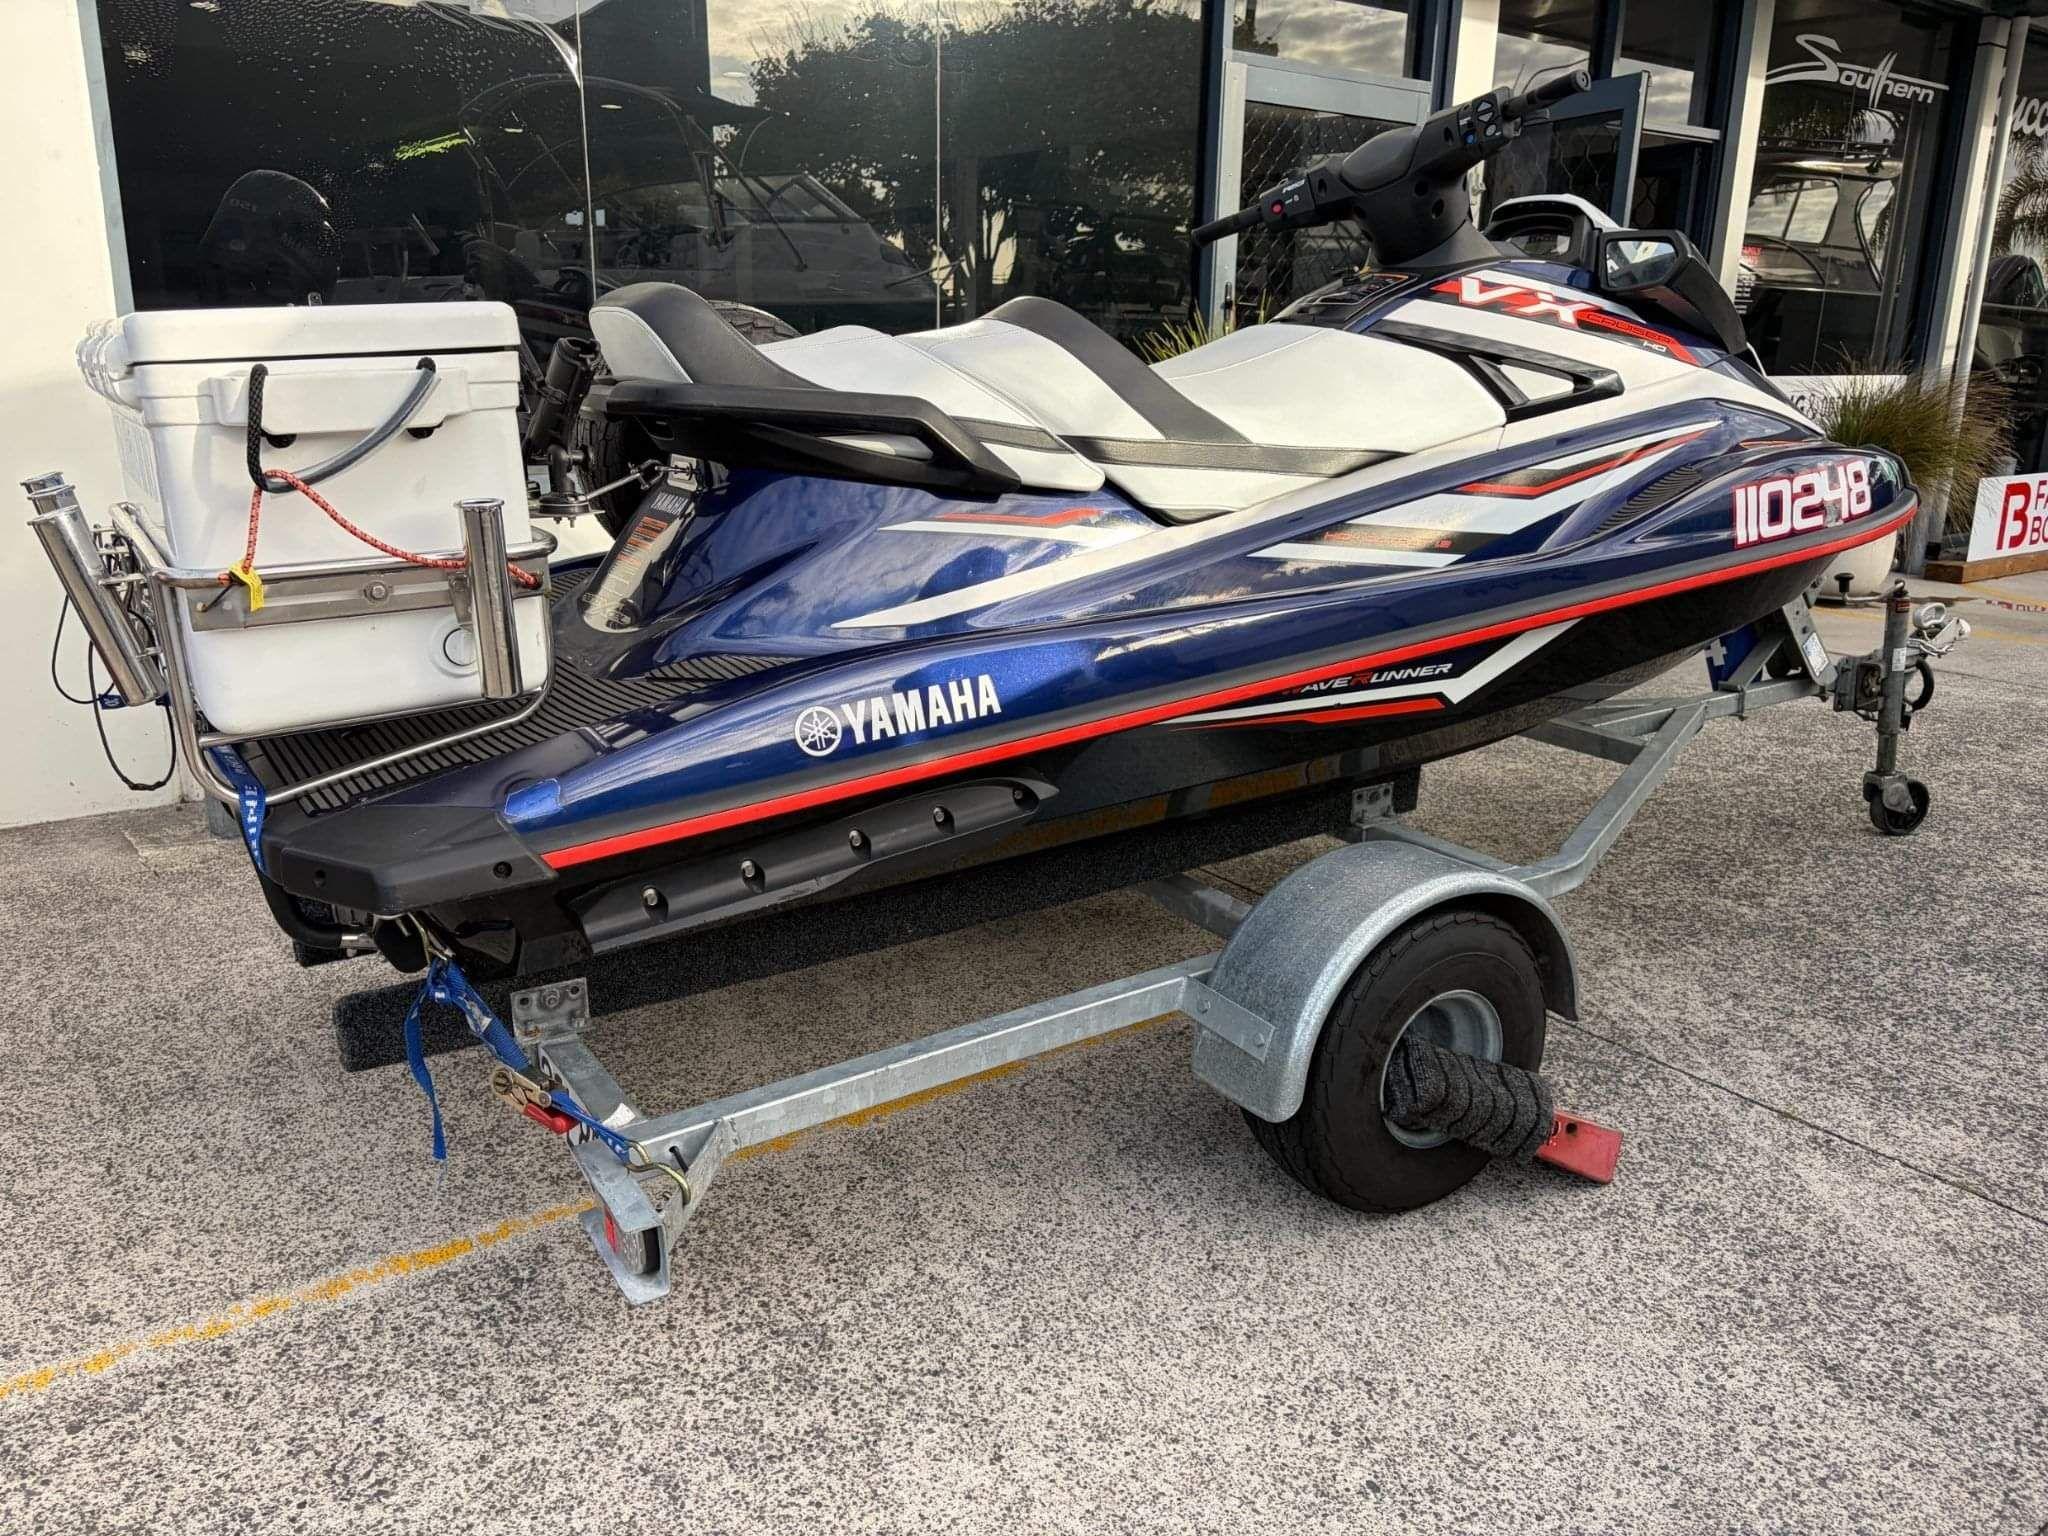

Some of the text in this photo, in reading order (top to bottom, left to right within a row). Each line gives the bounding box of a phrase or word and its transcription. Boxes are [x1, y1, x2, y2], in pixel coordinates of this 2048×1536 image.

[1767, 34, 1949, 108] Southern
[1460, 276, 1600, 328] VX
[1734, 460, 1873, 546] 110248
[841, 674, 1002, 745] YAMAHA
[1281, 663, 1453, 695] AVERUNNER
